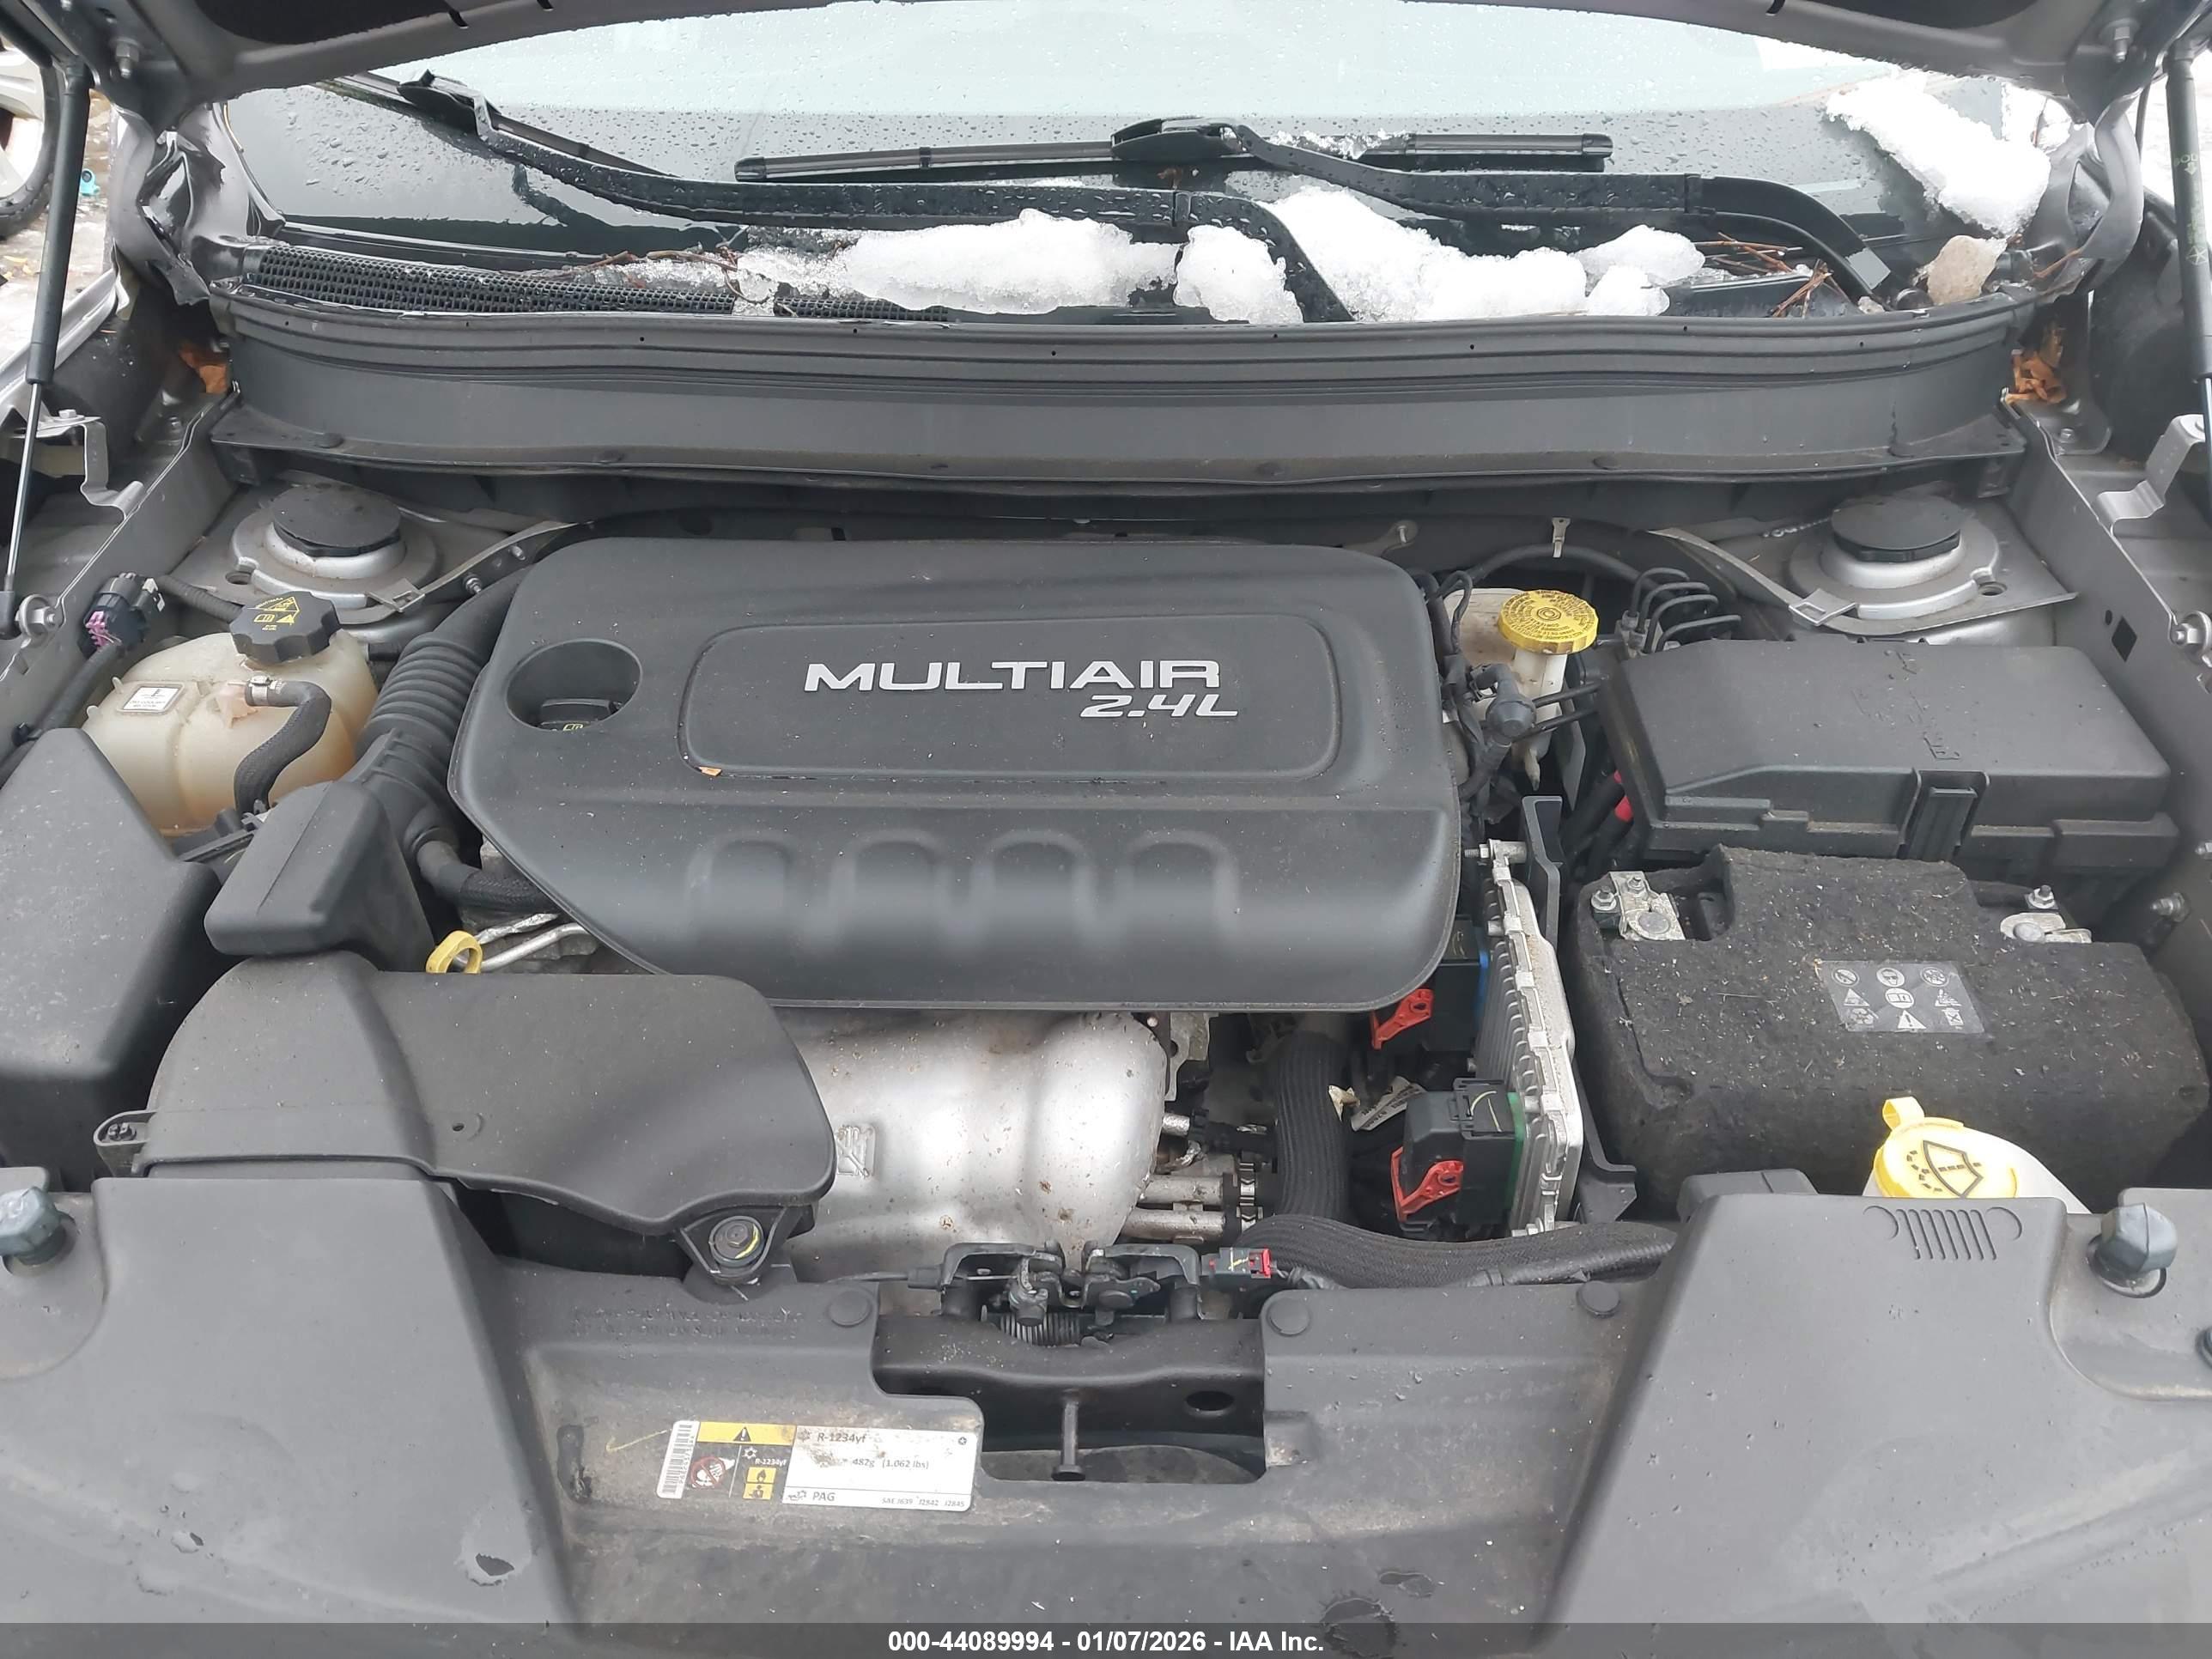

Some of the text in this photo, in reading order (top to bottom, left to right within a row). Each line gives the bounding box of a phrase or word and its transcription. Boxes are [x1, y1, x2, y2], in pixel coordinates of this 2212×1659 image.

[804, 659, 1220, 691] MULTIAIR
[1080, 694, 1238, 717] 2.4L
[817, 1432, 866, 1443] R-1234yf
[852, 1458, 875, 1468] 482g
[882, 1459, 910, 1469] (1.062
[912, 1460, 929, 1469] lbs)
[812, 1491, 836, 1502] PAG
